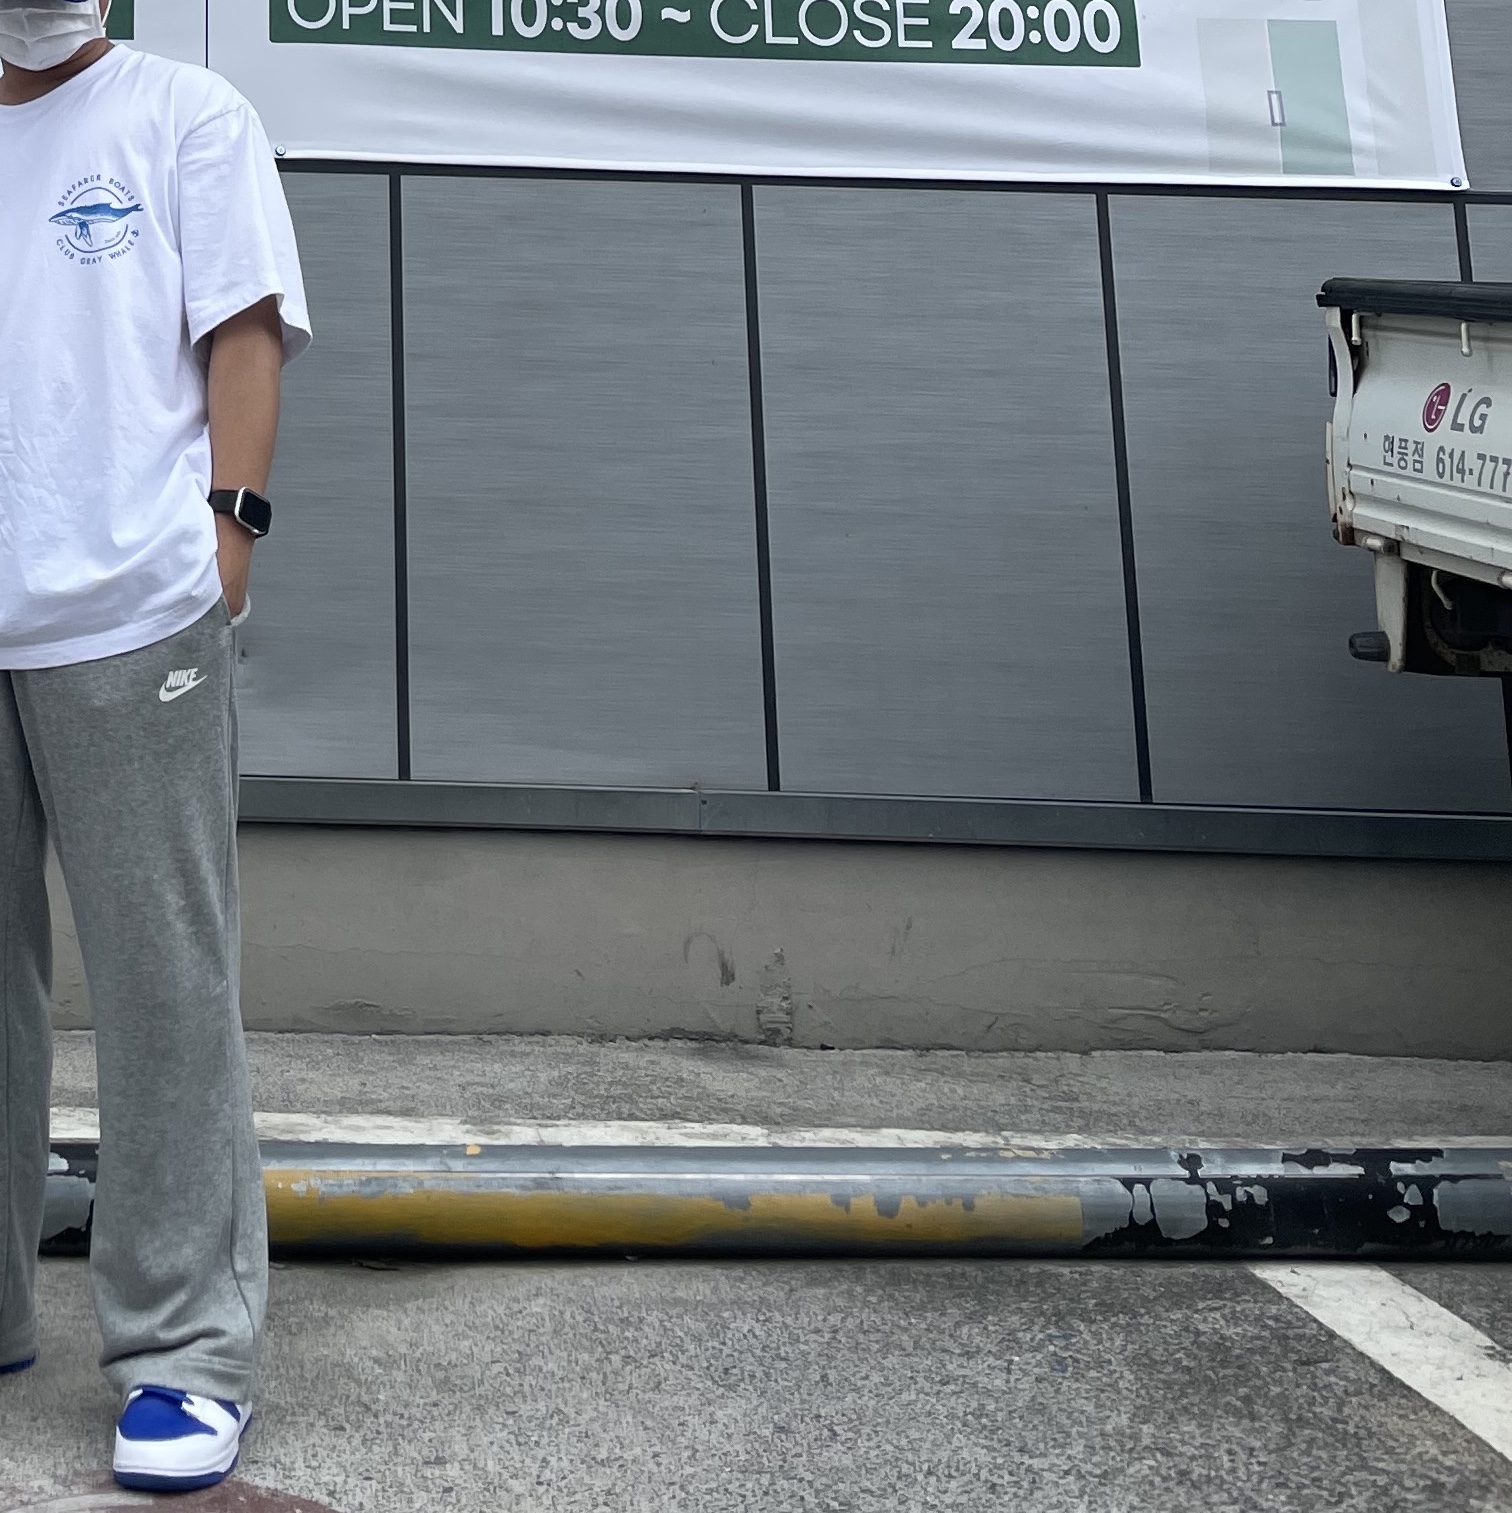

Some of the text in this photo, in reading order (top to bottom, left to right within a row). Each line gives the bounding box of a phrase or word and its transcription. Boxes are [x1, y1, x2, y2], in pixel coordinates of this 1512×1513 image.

[1450, 391, 1492, 434] LG
[1382, 433, 1425, 474] 현풍점
[166, 668, 199, 689] NIKE
